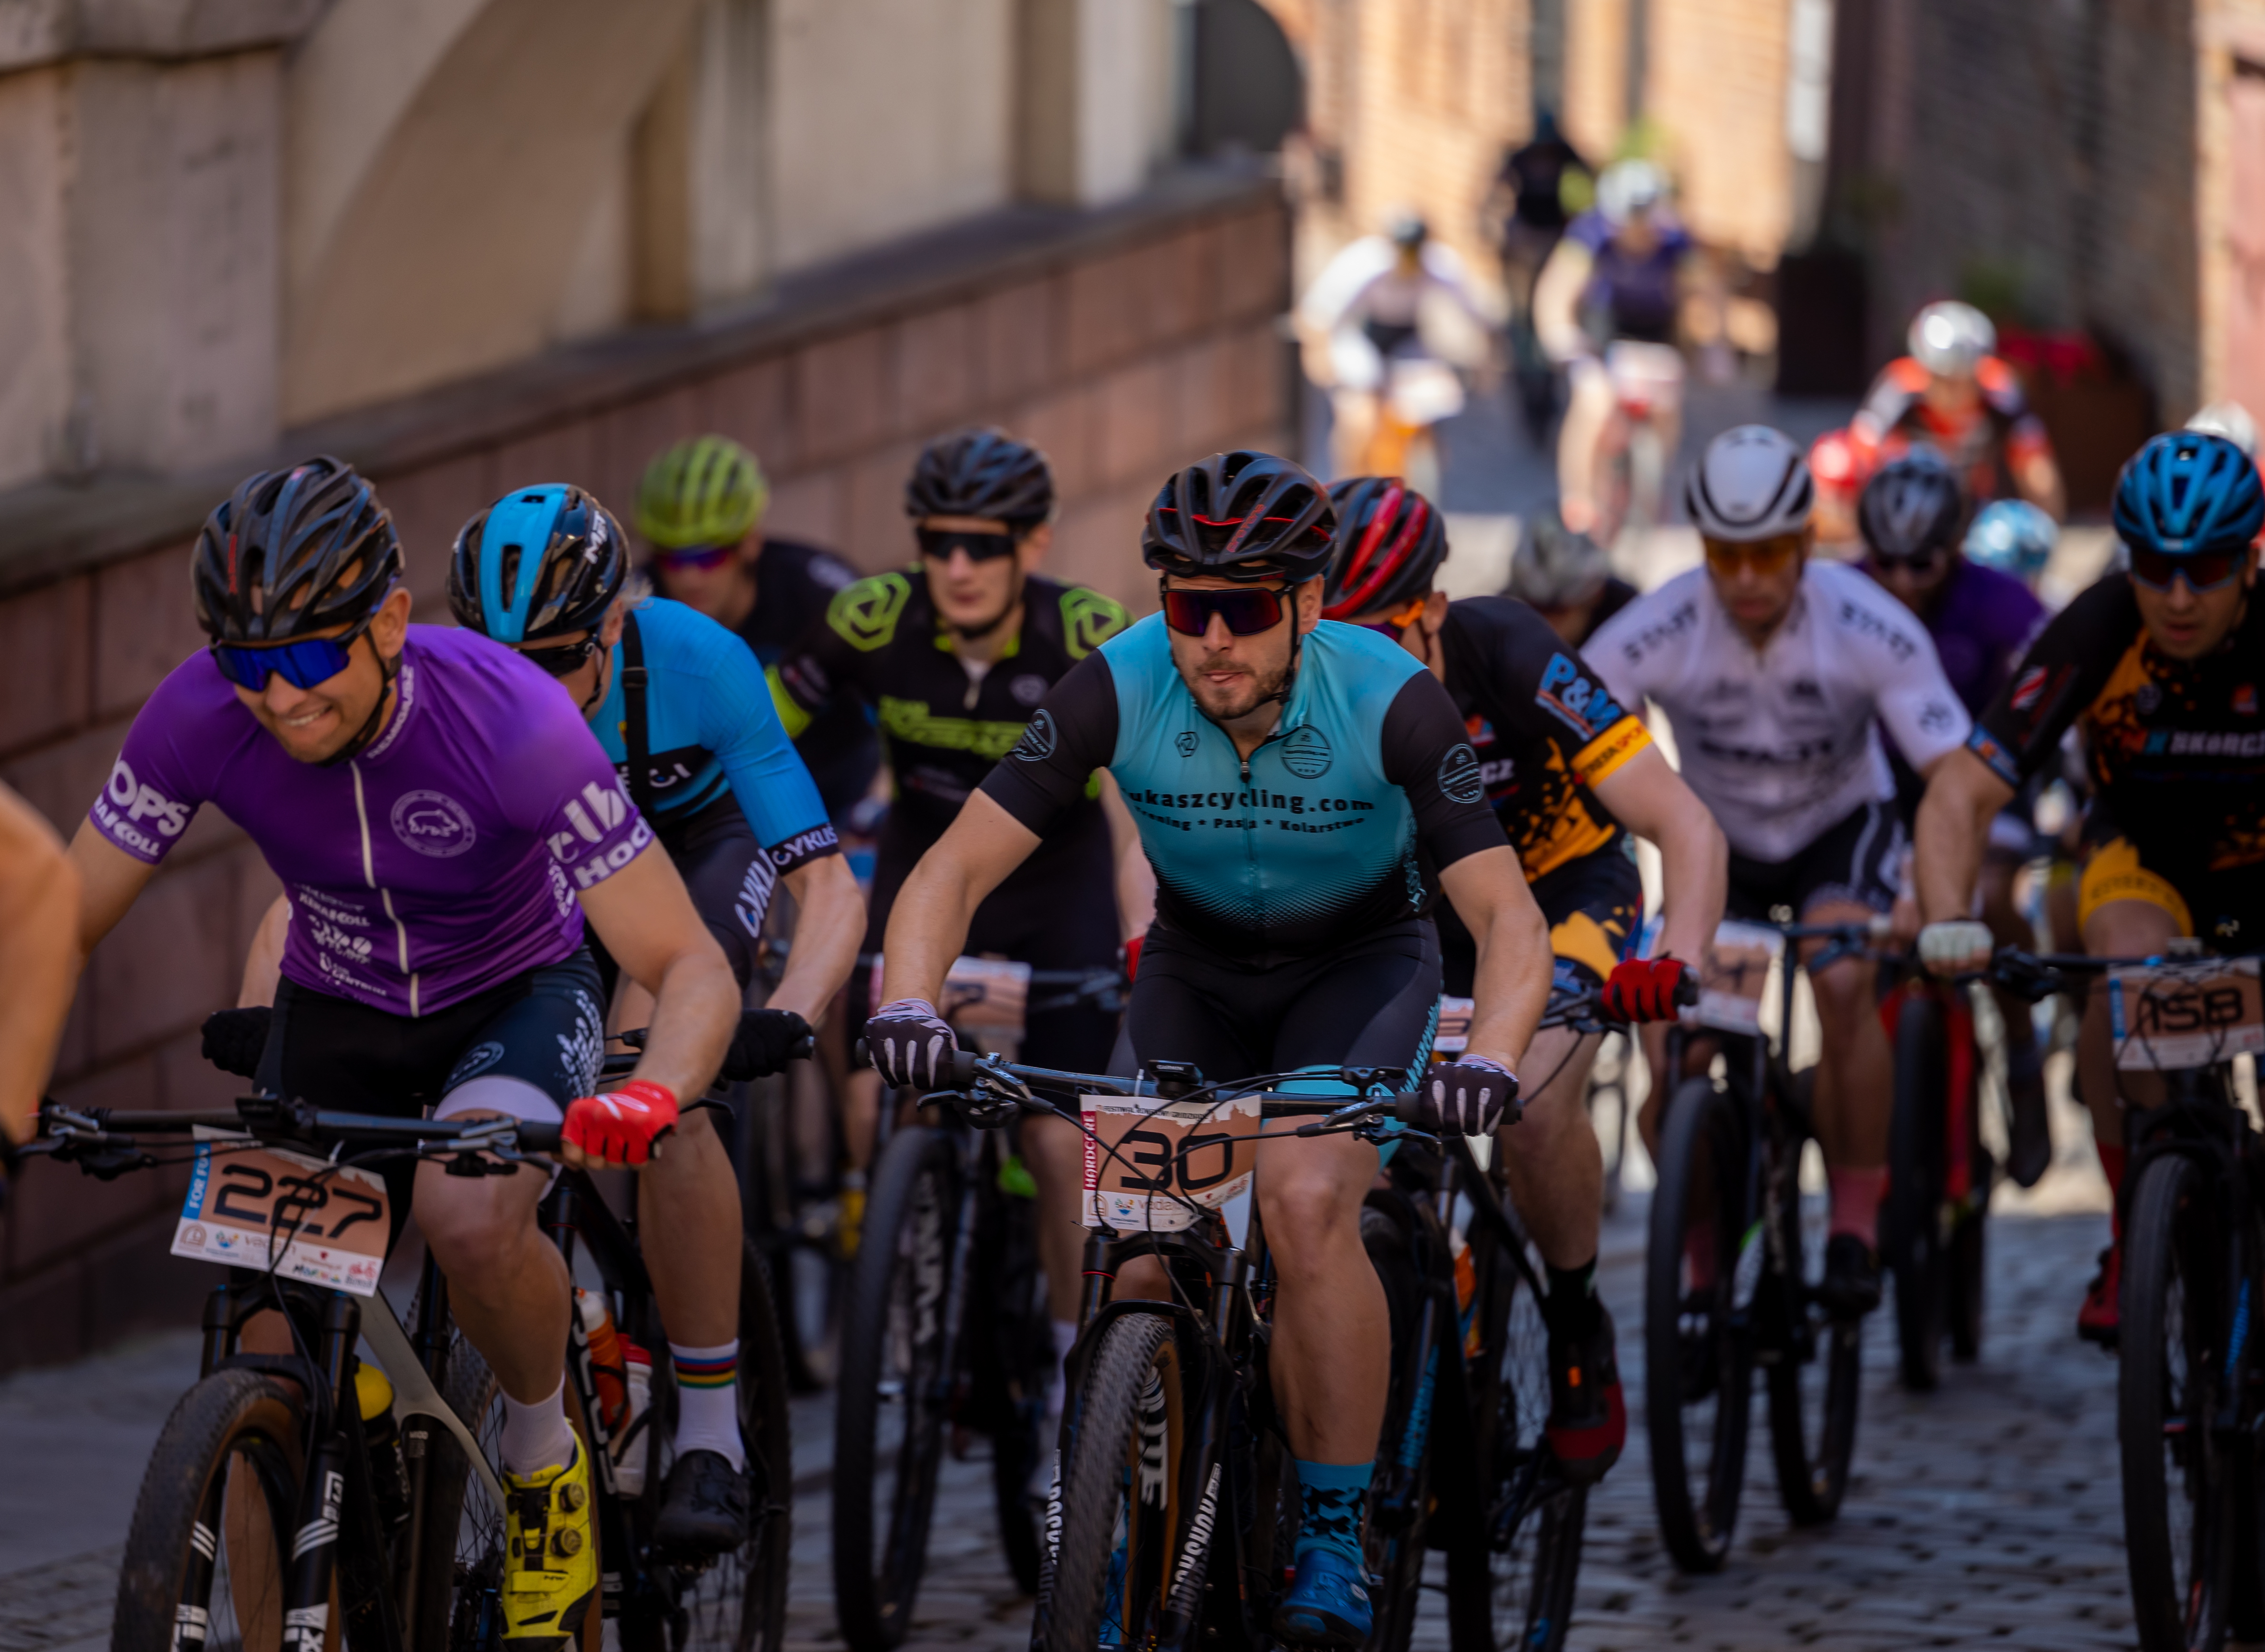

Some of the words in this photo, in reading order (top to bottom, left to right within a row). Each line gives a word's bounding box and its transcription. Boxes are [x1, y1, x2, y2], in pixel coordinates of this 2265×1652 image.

[108, 759, 191, 837] OPS
[1121, 787, 1374, 814] ukaszcycling.com
[1280, 817, 1365, 833] Kolarstwo
[1119, 1129, 1233, 1191] 30
[189, 1173, 205, 1209] FOR
[213, 1164, 383, 1240] 227
